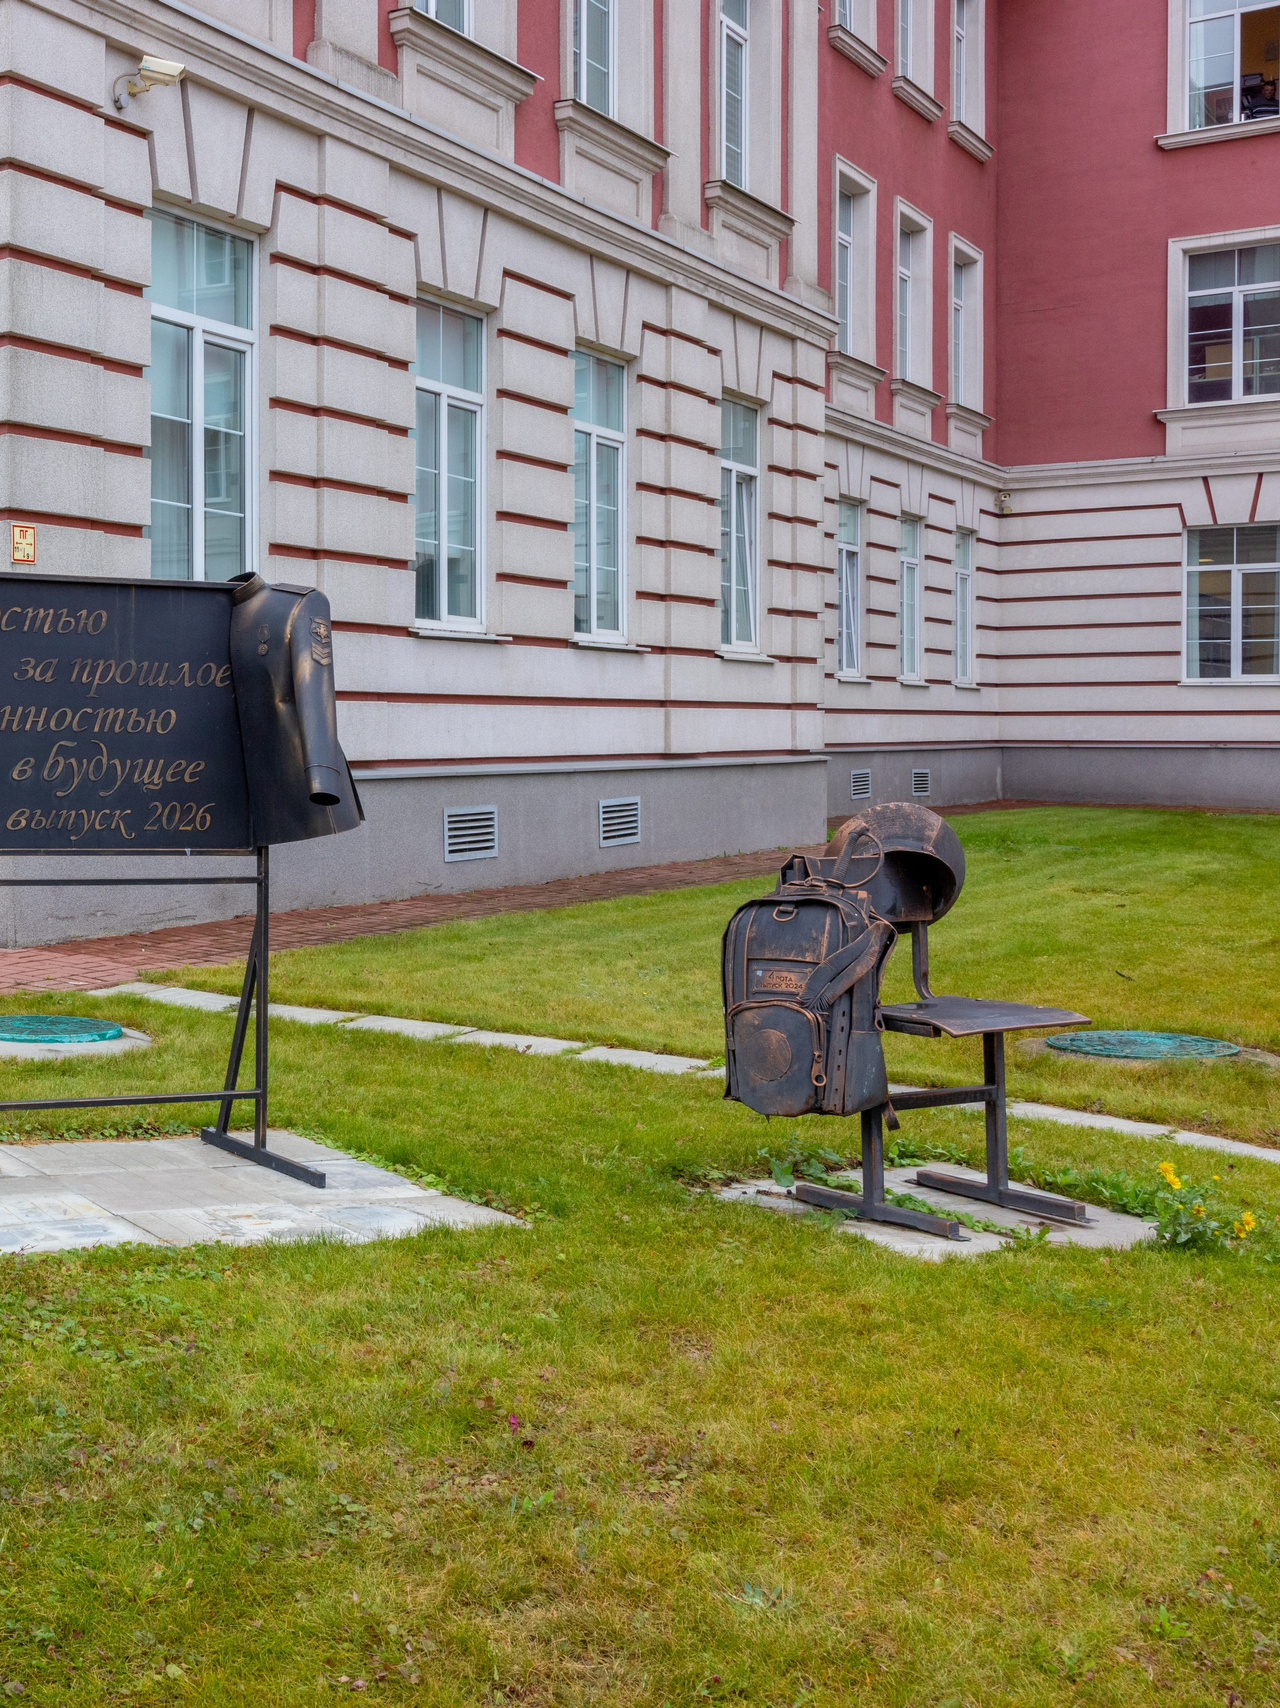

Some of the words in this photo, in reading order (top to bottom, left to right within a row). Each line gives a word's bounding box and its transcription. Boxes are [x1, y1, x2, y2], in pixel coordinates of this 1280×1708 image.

[13, 657, 59, 683] за
[70, 657, 233, 698] прошлое
[11, 757, 36, 781] в
[43, 740, 206, 797] будущее
[6, 808, 136, 841] выпуск
[143, 802, 216, 831] 2026
